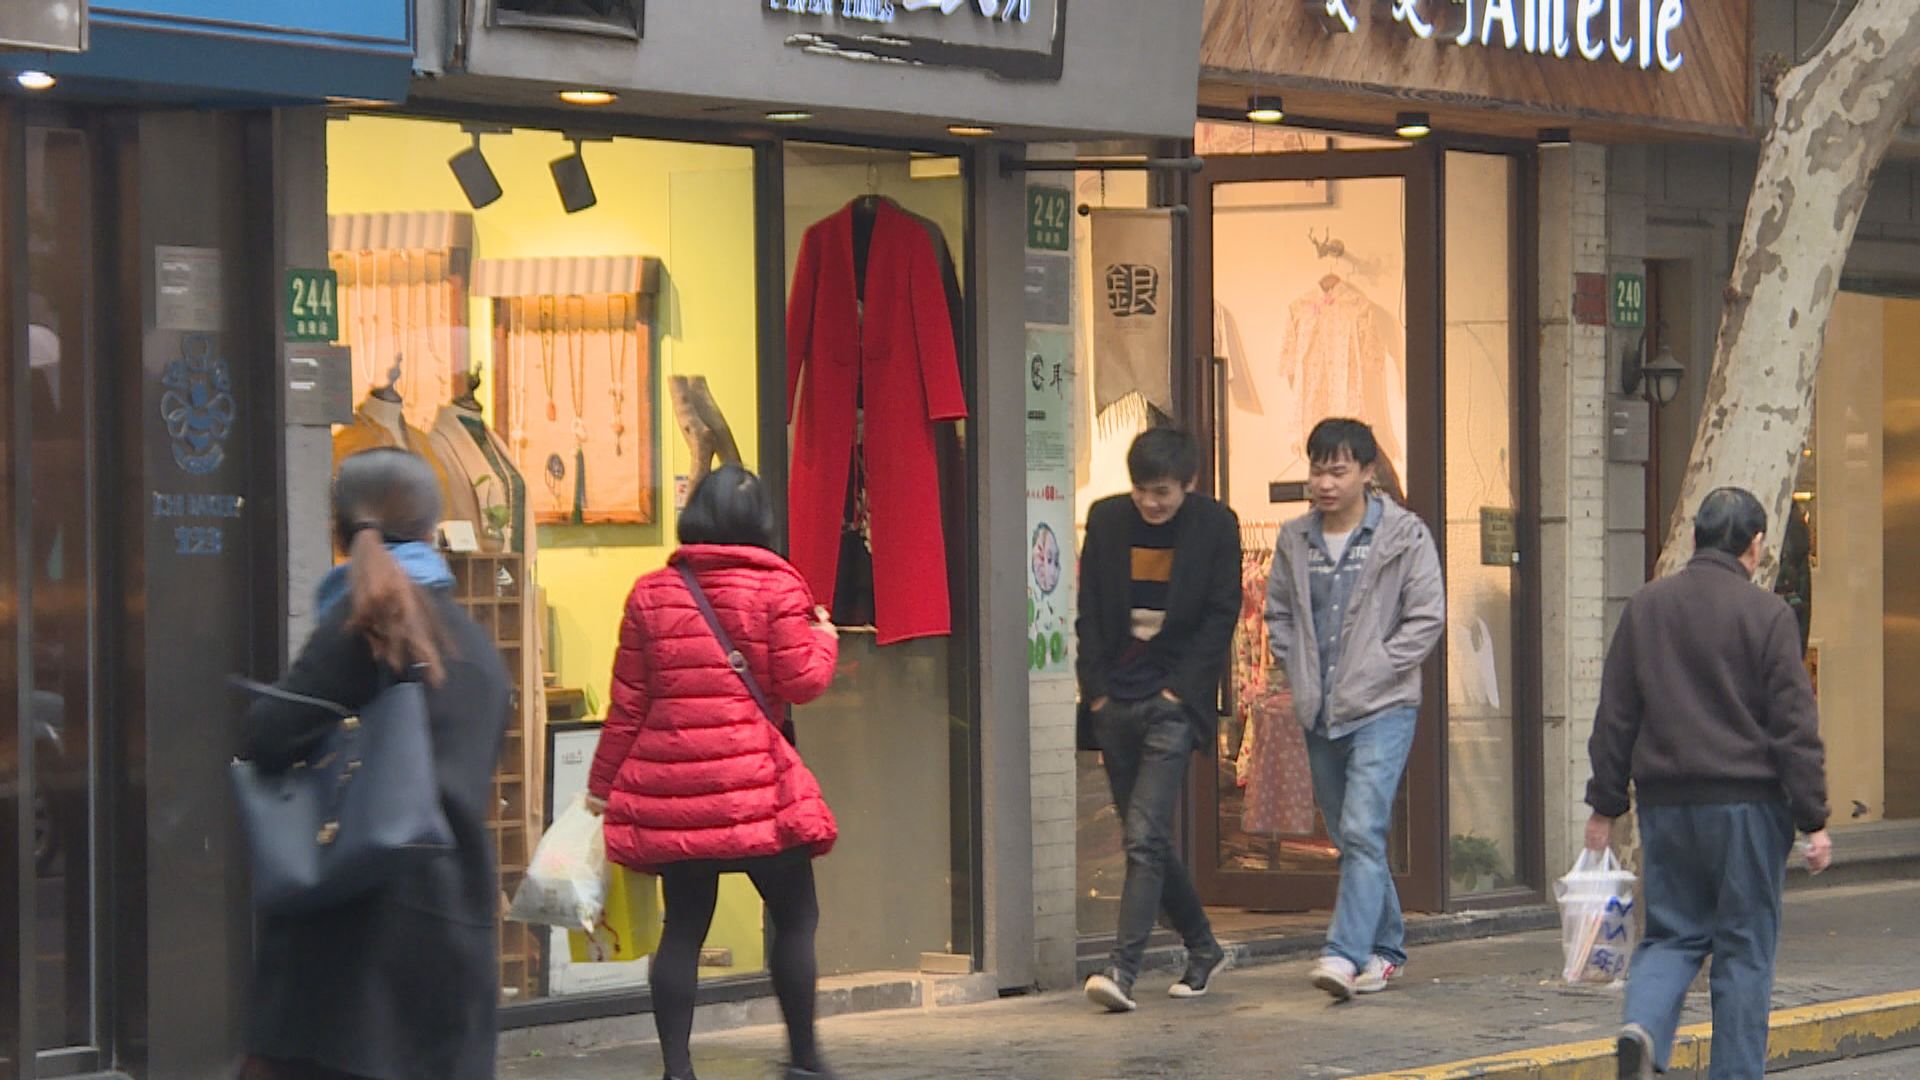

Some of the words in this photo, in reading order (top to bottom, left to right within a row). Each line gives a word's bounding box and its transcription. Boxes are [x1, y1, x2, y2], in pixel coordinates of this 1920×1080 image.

[1033, 194, 1065, 228] 242
[292, 277, 332, 316] 244
[1617, 279, 1641, 308] 240
